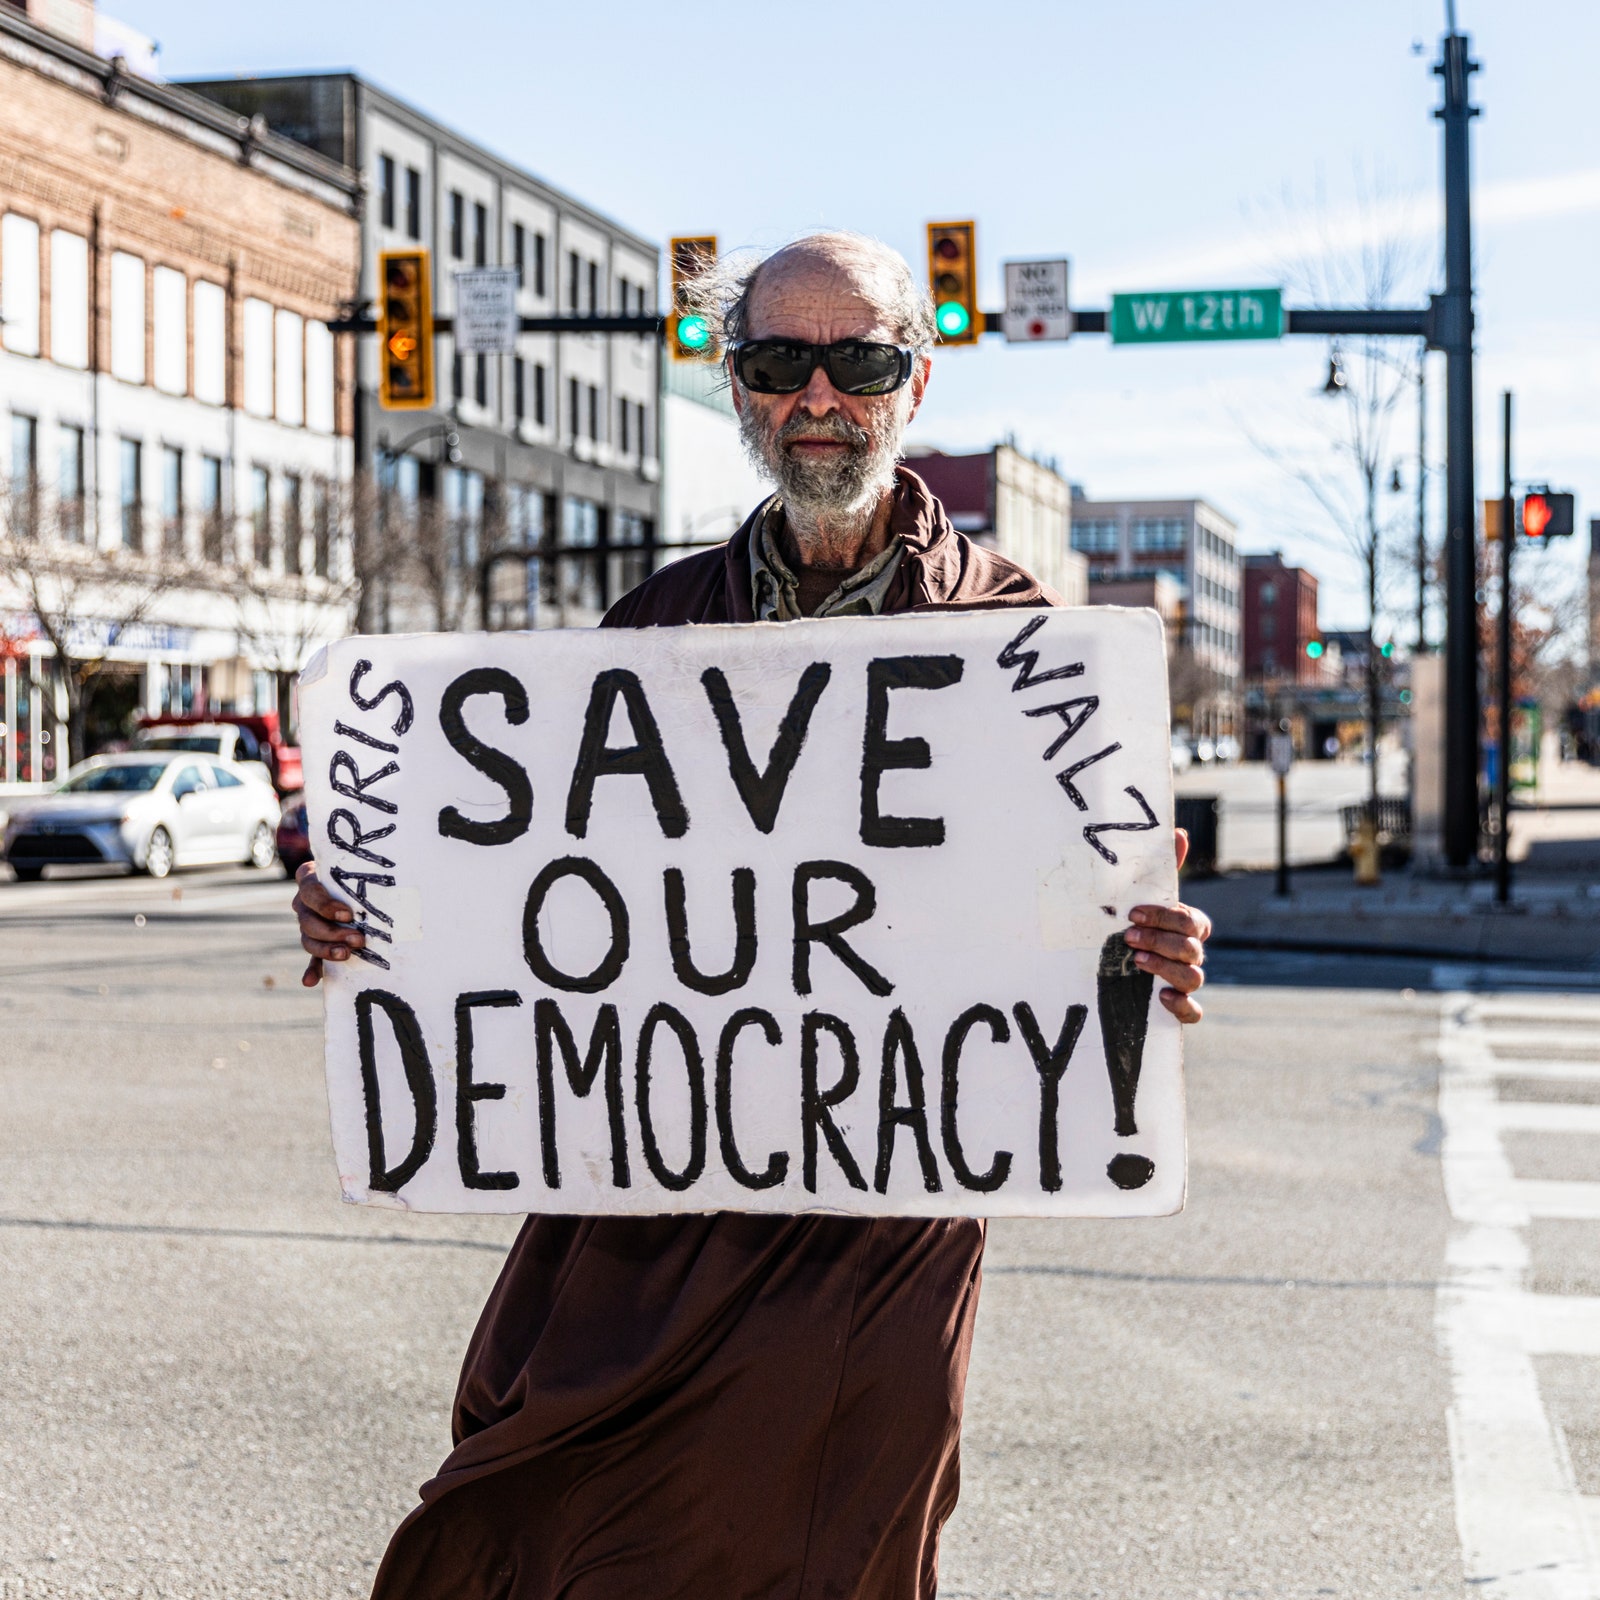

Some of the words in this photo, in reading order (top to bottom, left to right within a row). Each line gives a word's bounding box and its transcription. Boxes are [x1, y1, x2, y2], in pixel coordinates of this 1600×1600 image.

[1131, 301, 1169, 331] W
[1182, 296, 1263, 330] 12th
[328, 658, 414, 971] HARRIS
[438, 653, 965, 848] SAVE
[997, 615, 1160, 866] WALZ
[522, 854, 896, 998] OUR
[354, 930, 1157, 1195] DEMOCRACY!
